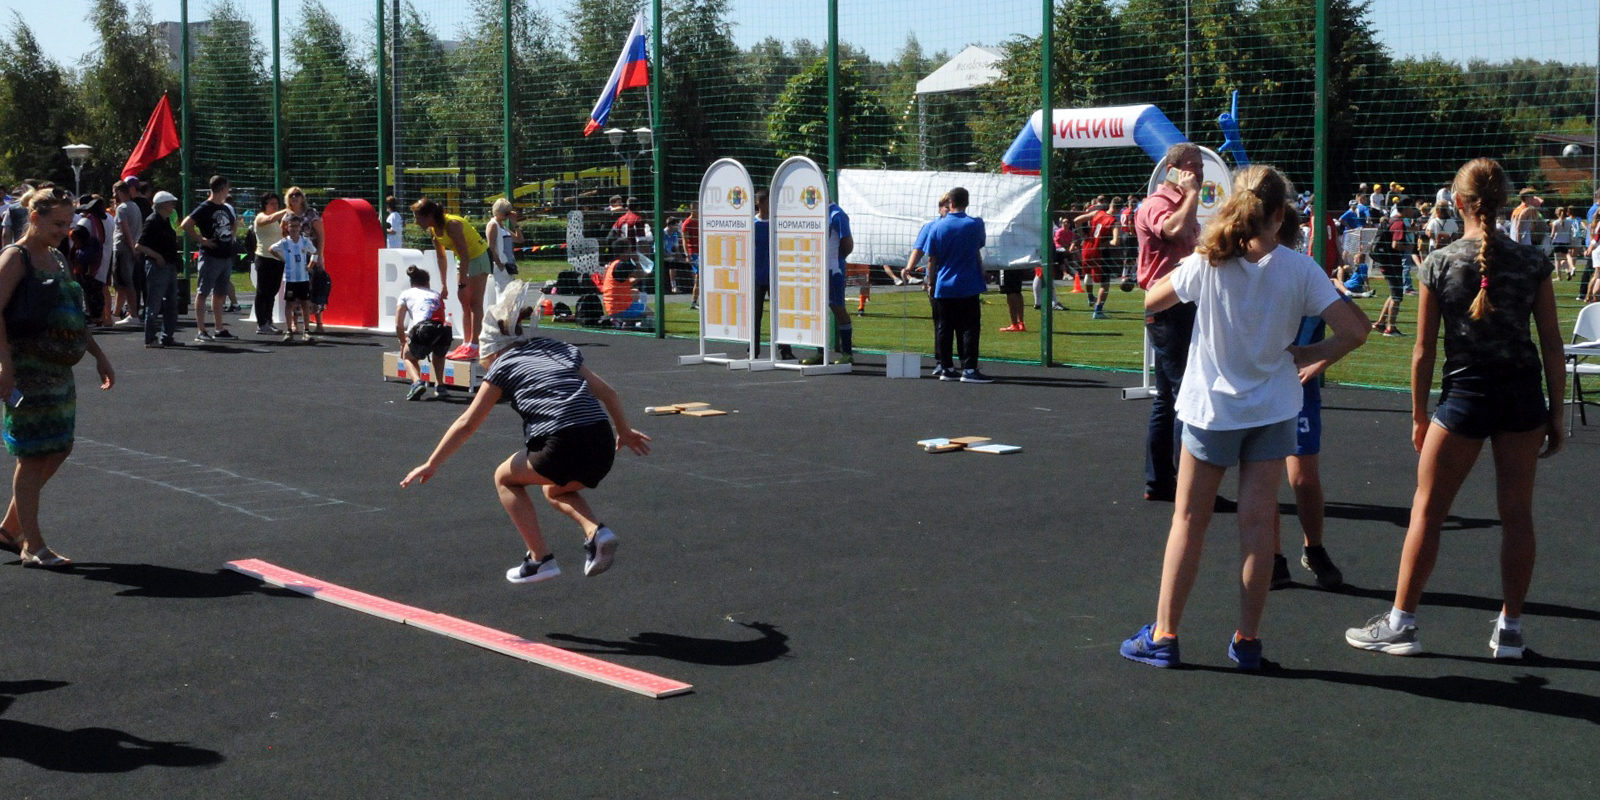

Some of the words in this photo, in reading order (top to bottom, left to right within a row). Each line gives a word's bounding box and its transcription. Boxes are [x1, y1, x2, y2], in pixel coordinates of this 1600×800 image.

[1053, 117, 1124, 139] ИНИШ
[706, 220, 747, 229] НОРМАТИВЫ
[778, 220, 821, 230] НОРМАТИВЫ
